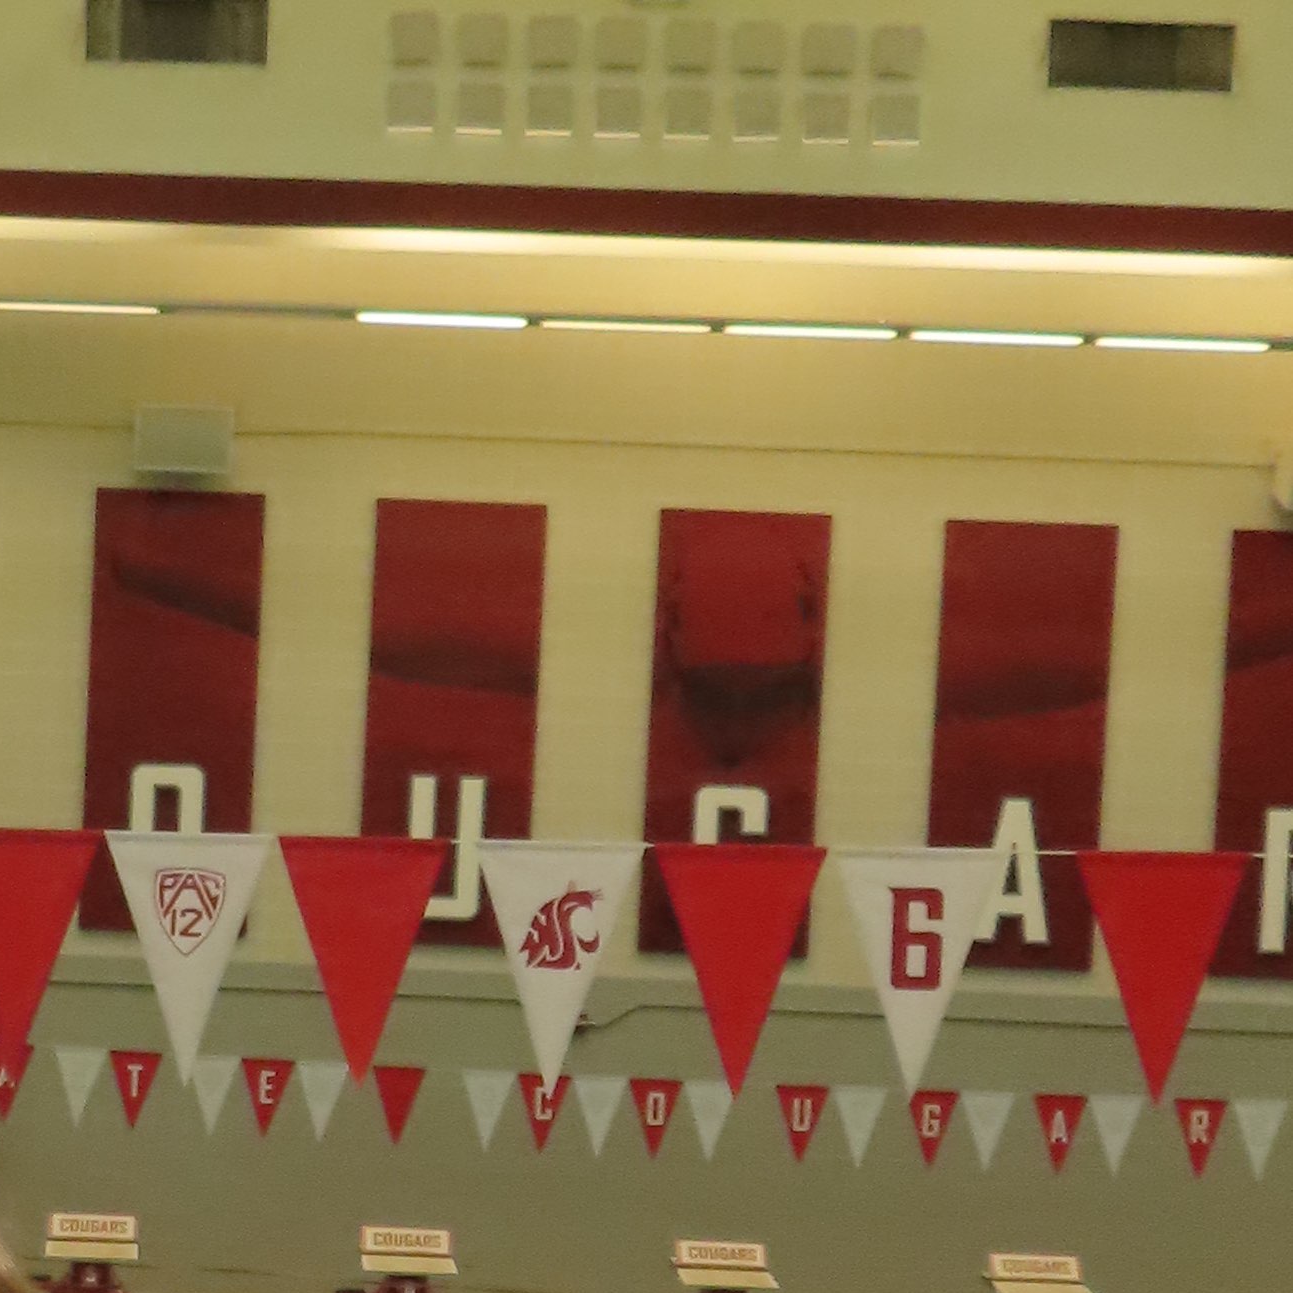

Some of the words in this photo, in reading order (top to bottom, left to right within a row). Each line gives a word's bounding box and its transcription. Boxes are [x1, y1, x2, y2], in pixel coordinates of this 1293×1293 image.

[973, 797, 1049, 945] A
[159, 873, 220, 920] PAC
[171, 908, 203, 937] 12
[889, 887, 944, 990] 6
[60, 1219, 128, 1233] COUGARS
[373, 1232, 441, 1247] COUGARS
